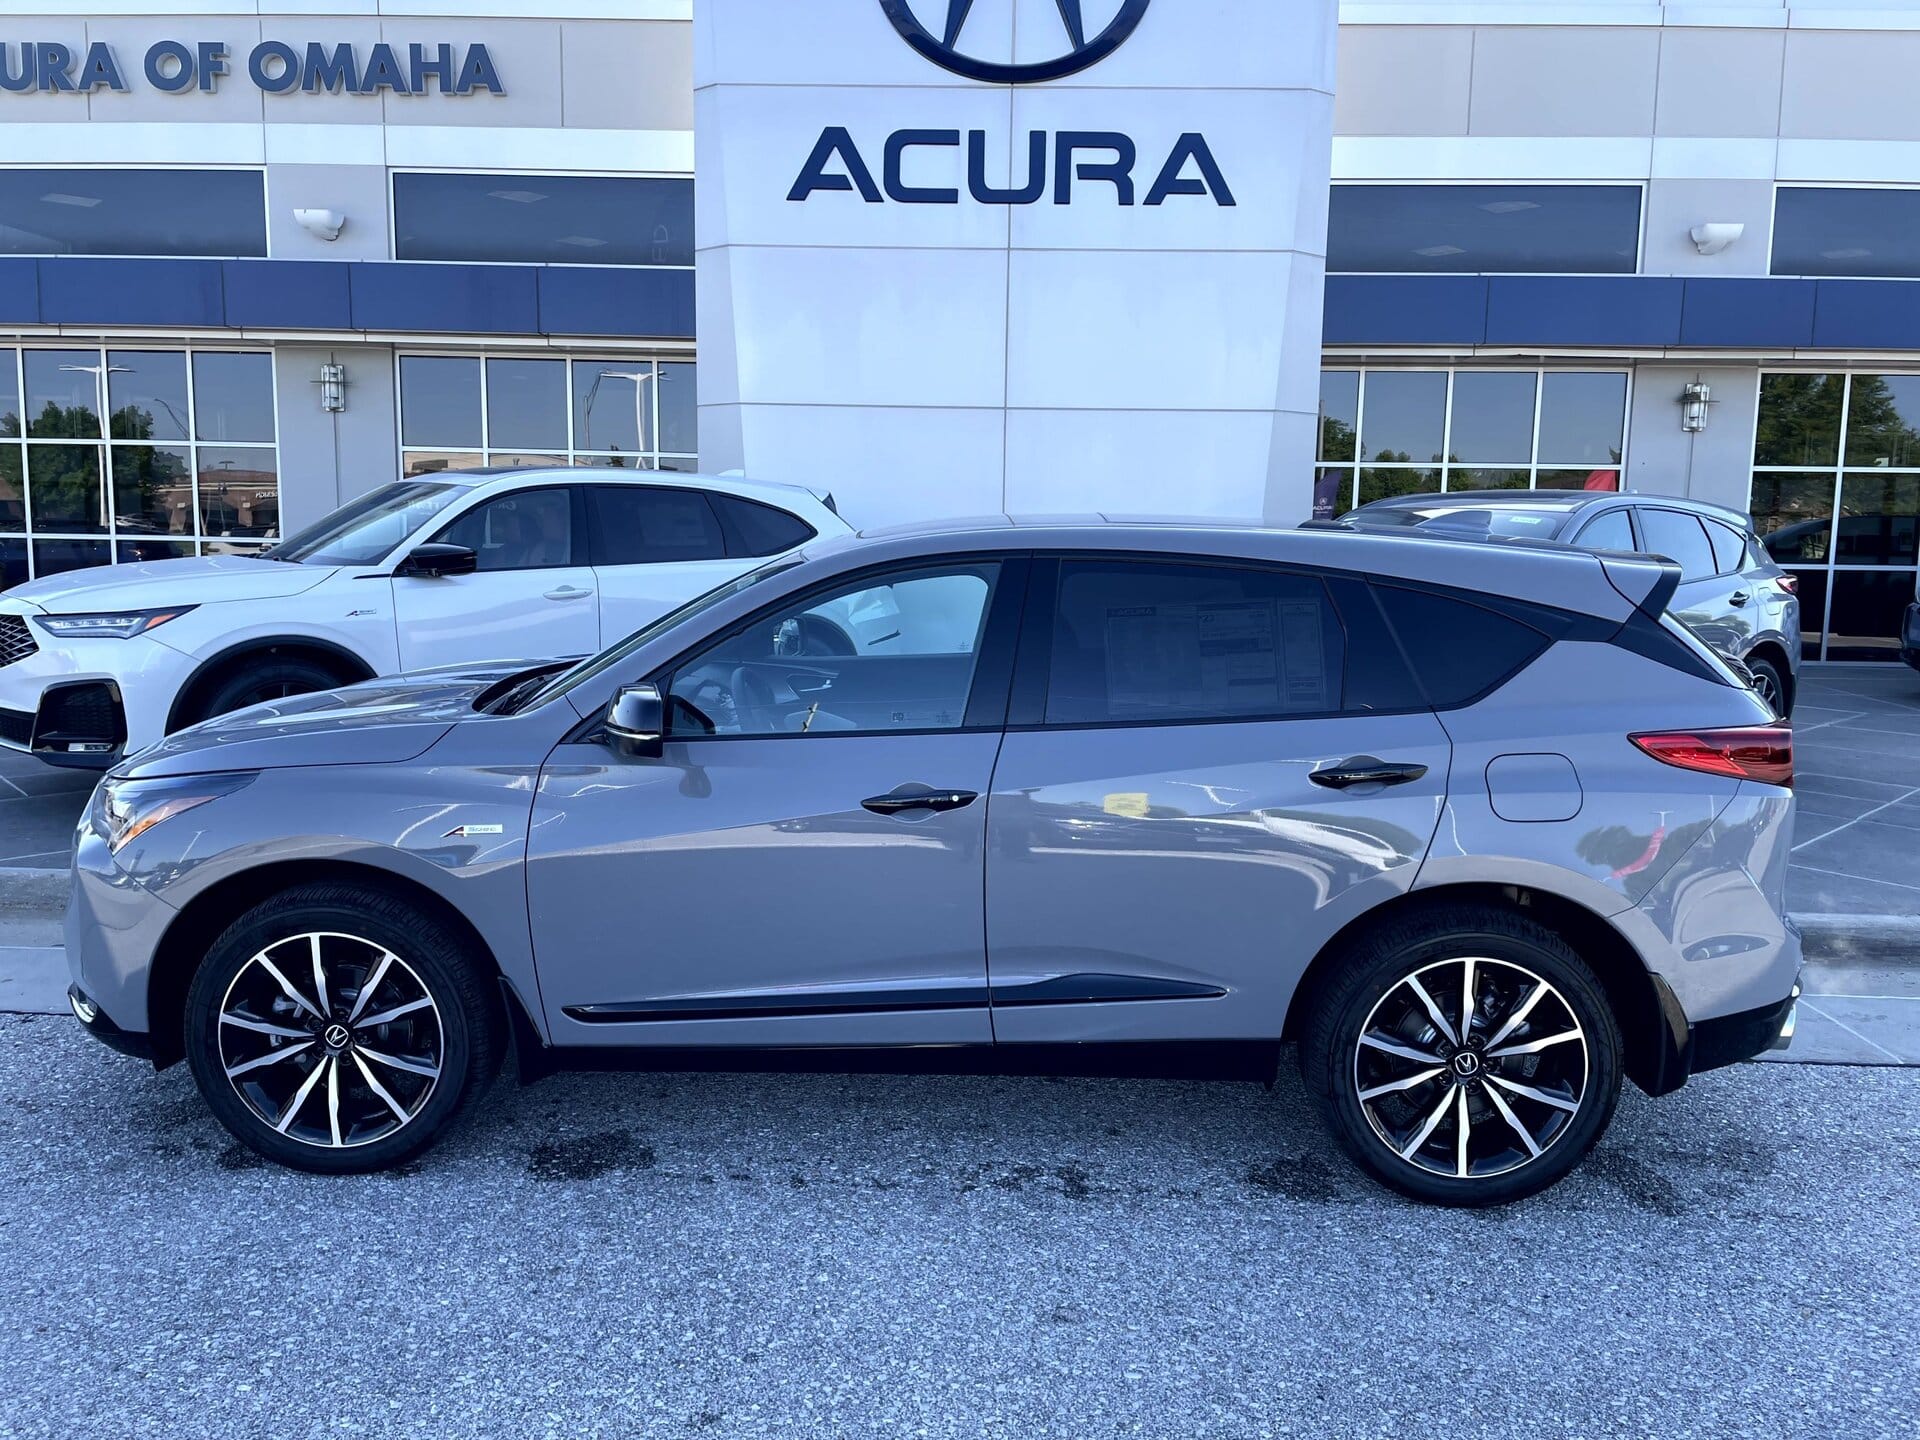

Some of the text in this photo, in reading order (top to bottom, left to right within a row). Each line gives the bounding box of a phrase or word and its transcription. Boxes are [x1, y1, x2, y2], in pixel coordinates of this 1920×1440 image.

[144, 40, 226, 92] OF
[248, 41, 504, 96] OMAHA
[786, 126, 1237, 206] ACURA
